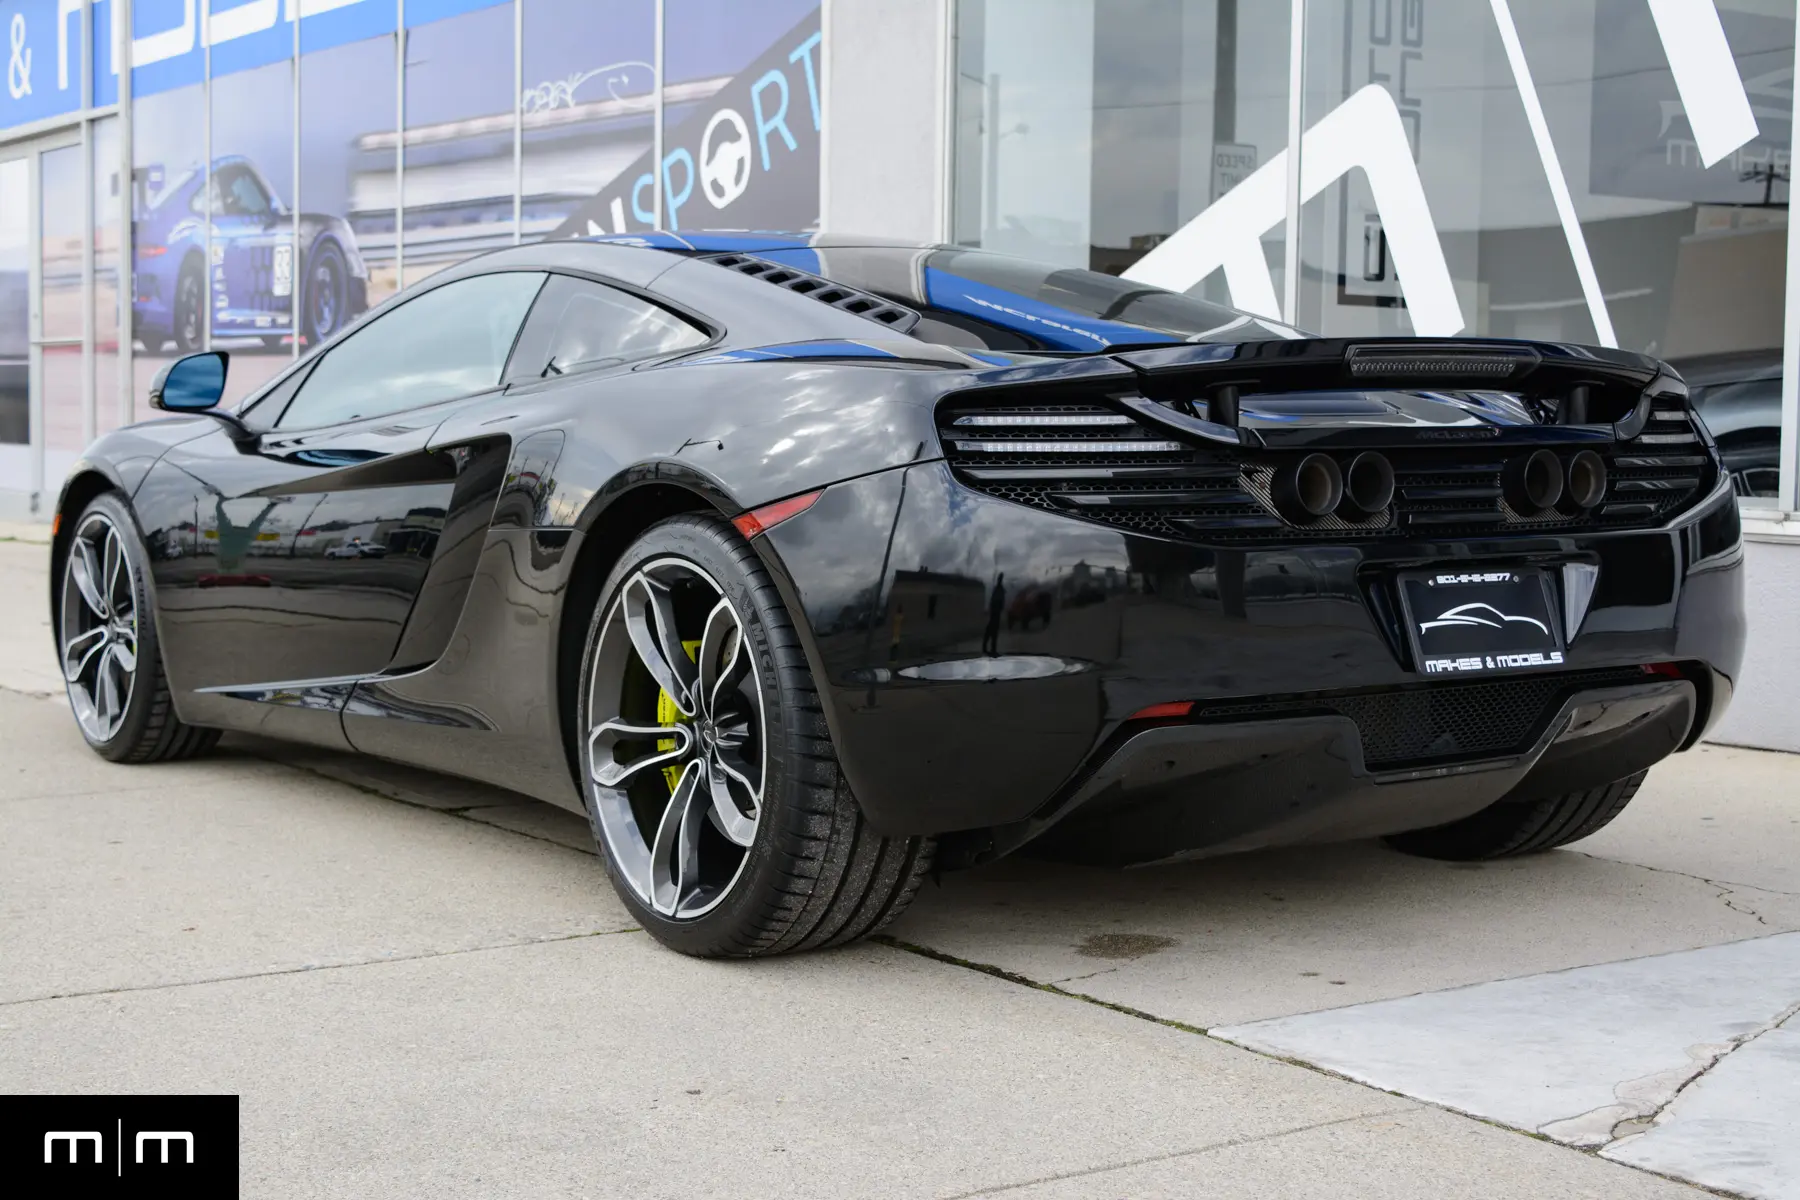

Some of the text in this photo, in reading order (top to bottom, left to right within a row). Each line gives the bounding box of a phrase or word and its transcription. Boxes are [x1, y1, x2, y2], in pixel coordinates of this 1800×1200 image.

[8, 13, 32, 99] &
[1425, 651, 1564, 673] MAKES & MODELS
